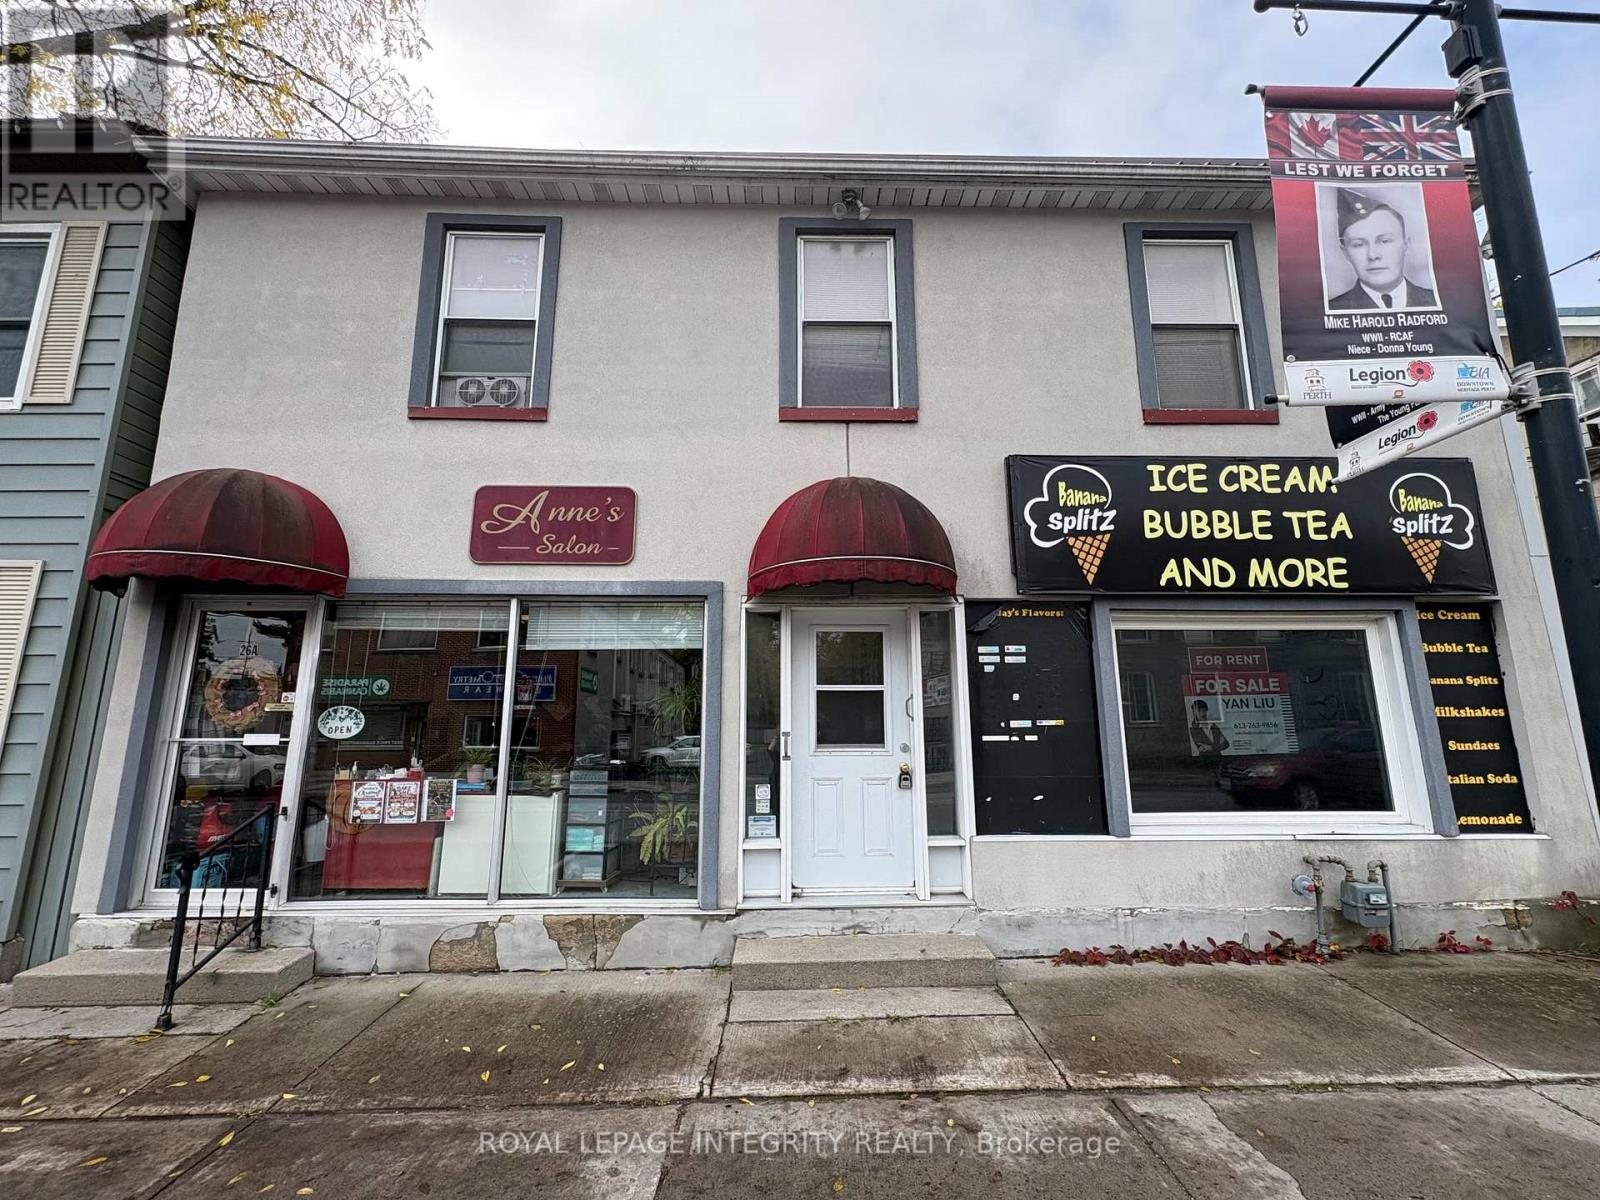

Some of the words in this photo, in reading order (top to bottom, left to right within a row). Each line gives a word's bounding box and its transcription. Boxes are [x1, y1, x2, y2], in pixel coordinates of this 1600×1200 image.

[1284, 162, 1330, 176] LEST
[1335, 164, 1364, 177] WE
[1371, 164, 1448, 177] FORGET
[1324, 315, 1350, 329] MIKE
[1352, 315, 1395, 328] HAROLD
[1397, 313, 1448, 326] RADFORD
[1361, 332, 1384, 342] WWII
[1389, 331, 1414, 341] RCAF
[1347, 345, 1371, 354] Niece
[1377, 344, 1404, 353] Donna
[1406, 342, 1433, 353] Young
[1349, 367, 1406, 384] Legion
[1303, 391, 1332, 399] PERTH
[1370, 404, 1386, 416] Army
[1377, 414, 1390, 424] The
[1389, 403, 1411, 418] Young
[1378, 425, 1416, 450] Legion
[1146, 463, 1208, 493] ICE
[1218, 463, 1339, 494] CREAM
[1058, 481, 1108, 507] Banana
[1398, 488, 1443, 513] Banana
[480, 490, 625, 534] Anne's
[1143, 509, 1274, 541] BUBBLE
[1282, 509, 1354, 540] TEA
[536, 534, 603, 554] Salon
[1159, 557, 1236, 588] AND
[1248, 557, 1349, 589] MORE
[1437, 610, 1481, 620] Cream
[240, 644, 258, 656] 26A
[1466, 643, 1489, 653] Tea
[1195, 655, 1222, 666] FOR
[1226, 654, 1261, 665] RENT
[1195, 679, 1231, 694] FOR
[1236, 678, 1280, 692] SALE
[1430, 677, 1464, 685] anana
[1466, 675, 1499, 686] Splits
[1222, 699, 1249, 709] YAN
[1253, 698, 1275, 709] LIU
[327, 725, 353, 734] OPEN
[1448, 740, 1500, 750] Sundaes
[1448, 774, 1485, 784] talian
[1487, 773, 1519, 784] Soda
[1457, 813, 1523, 825] emonade
